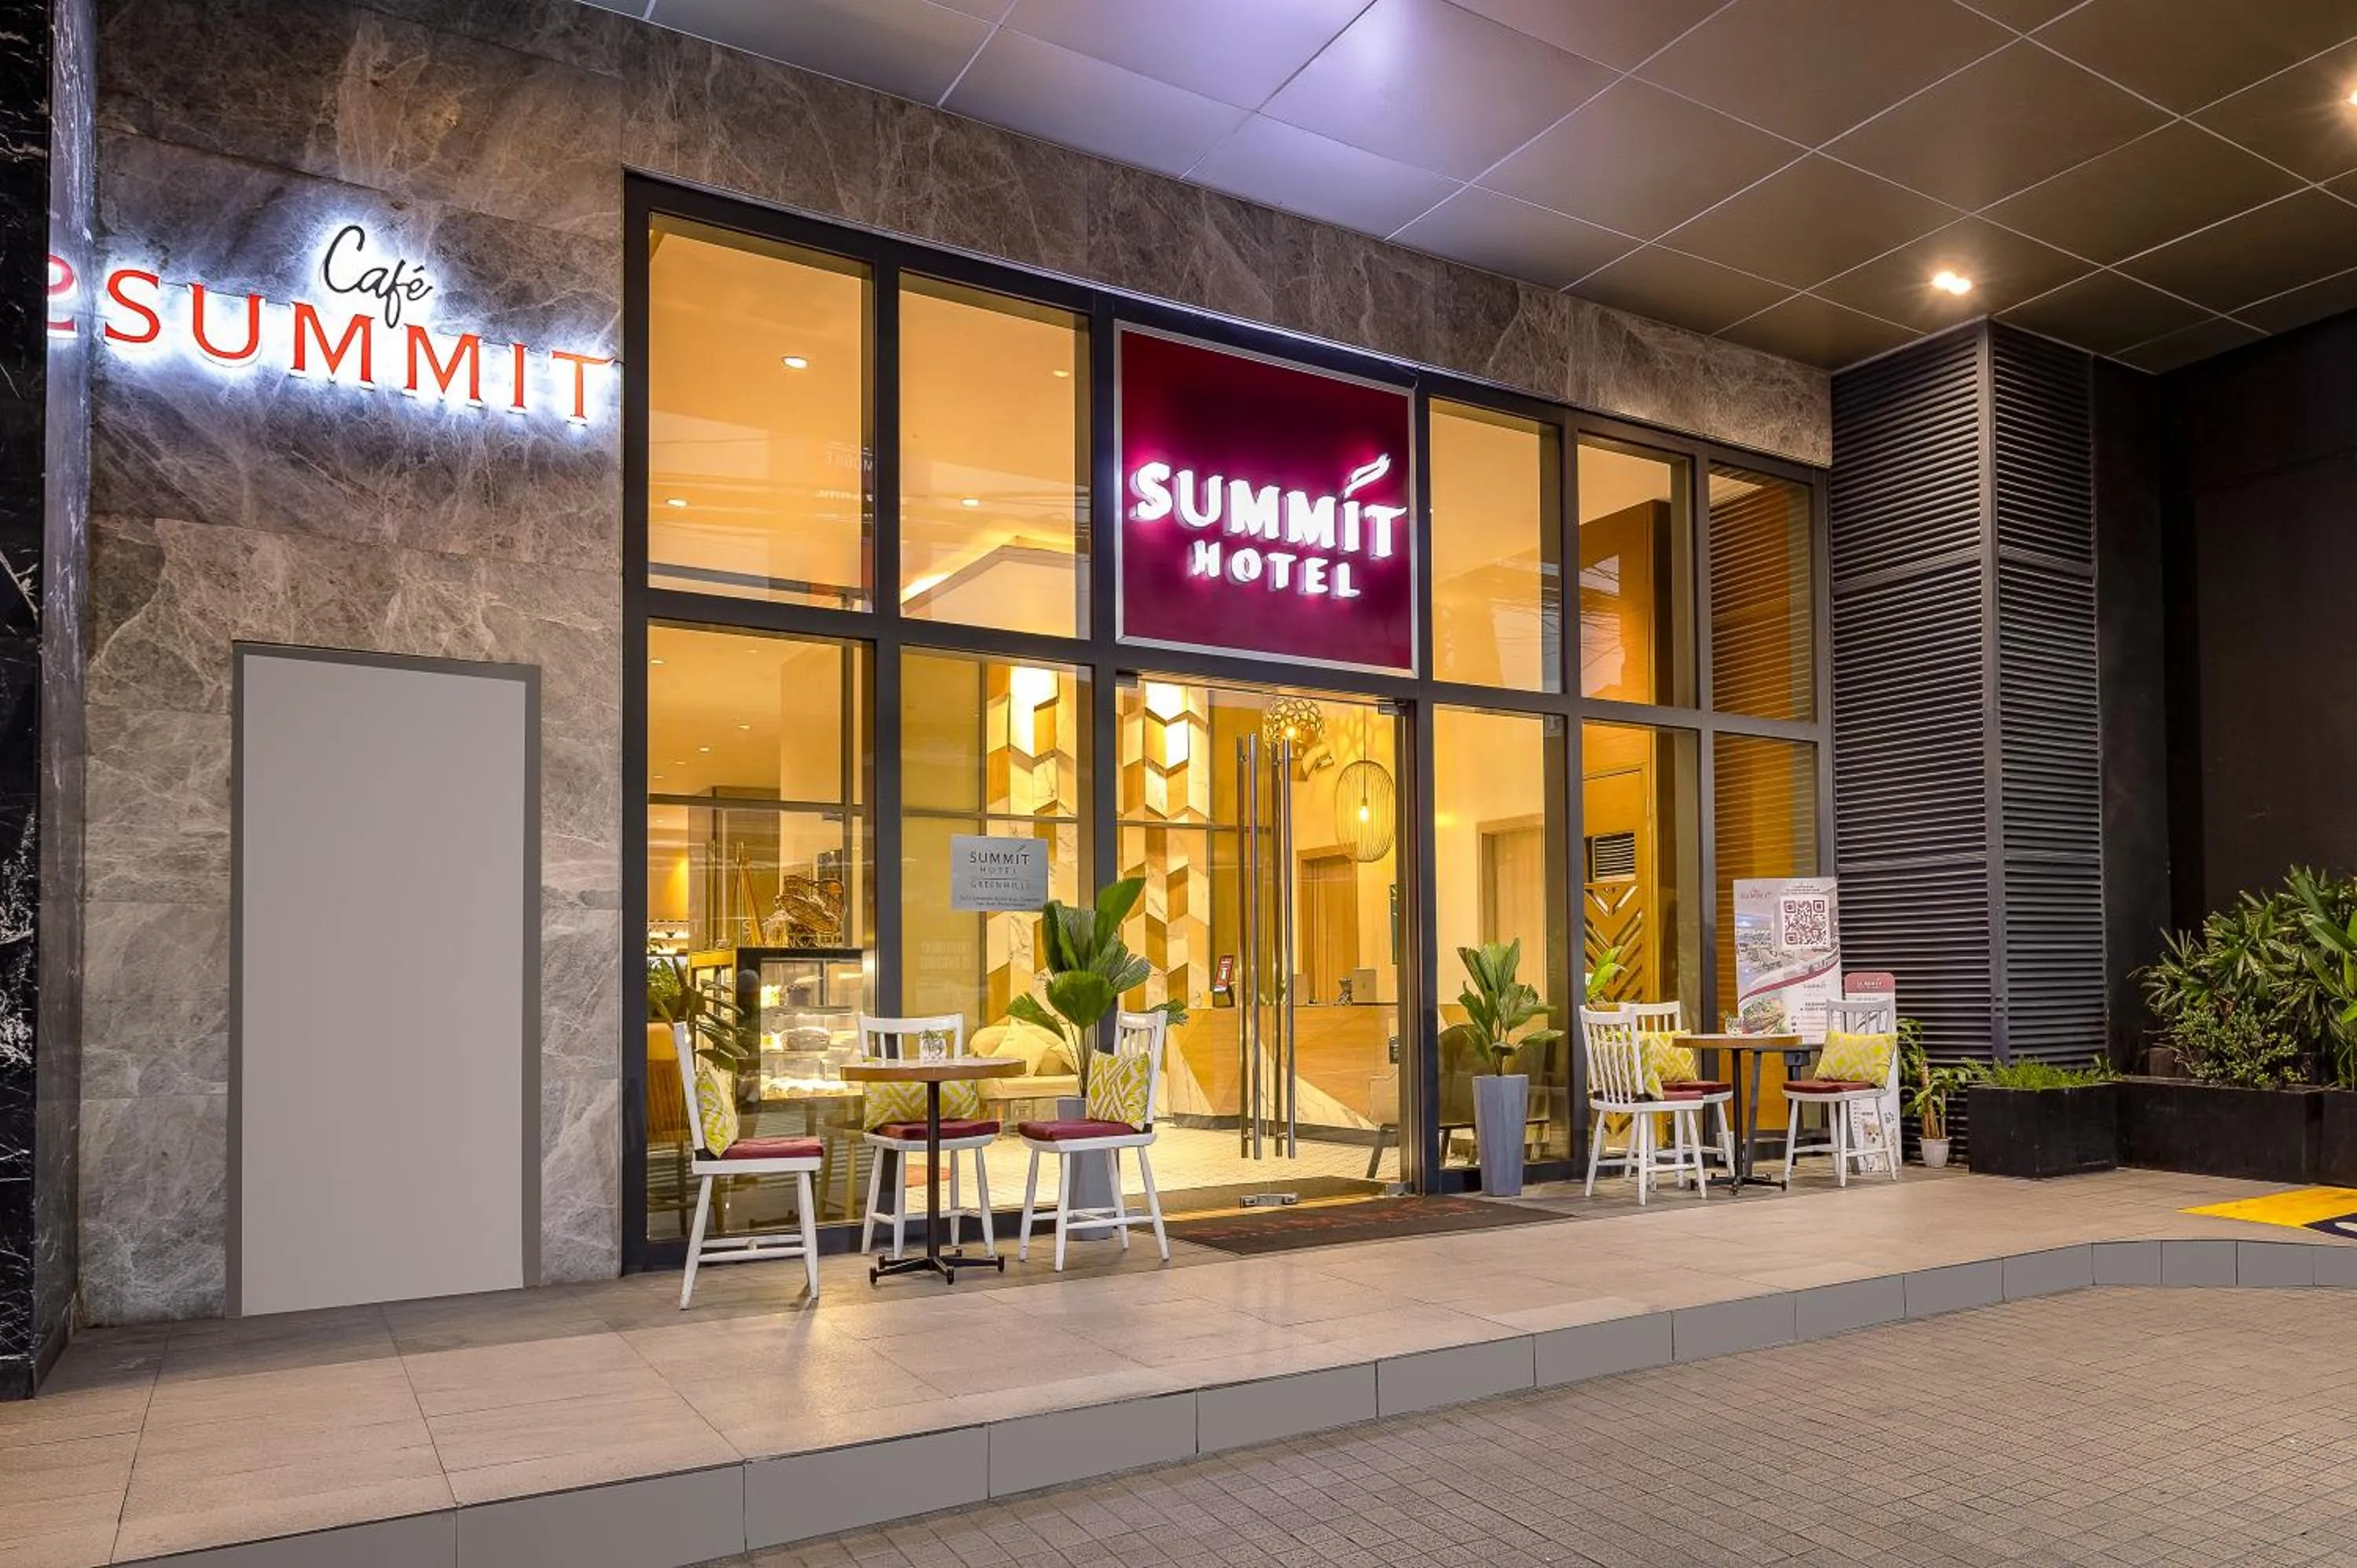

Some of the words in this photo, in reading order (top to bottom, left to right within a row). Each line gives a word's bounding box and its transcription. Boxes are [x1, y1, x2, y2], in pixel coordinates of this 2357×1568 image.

[324, 225, 434, 329] Café
[104, 269, 616, 421] SUMMIT
[1130, 453, 1407, 560] SUMMIT
[1189, 539, 1361, 599] HOTEL
[970, 844, 1030, 865] SUMMIT
